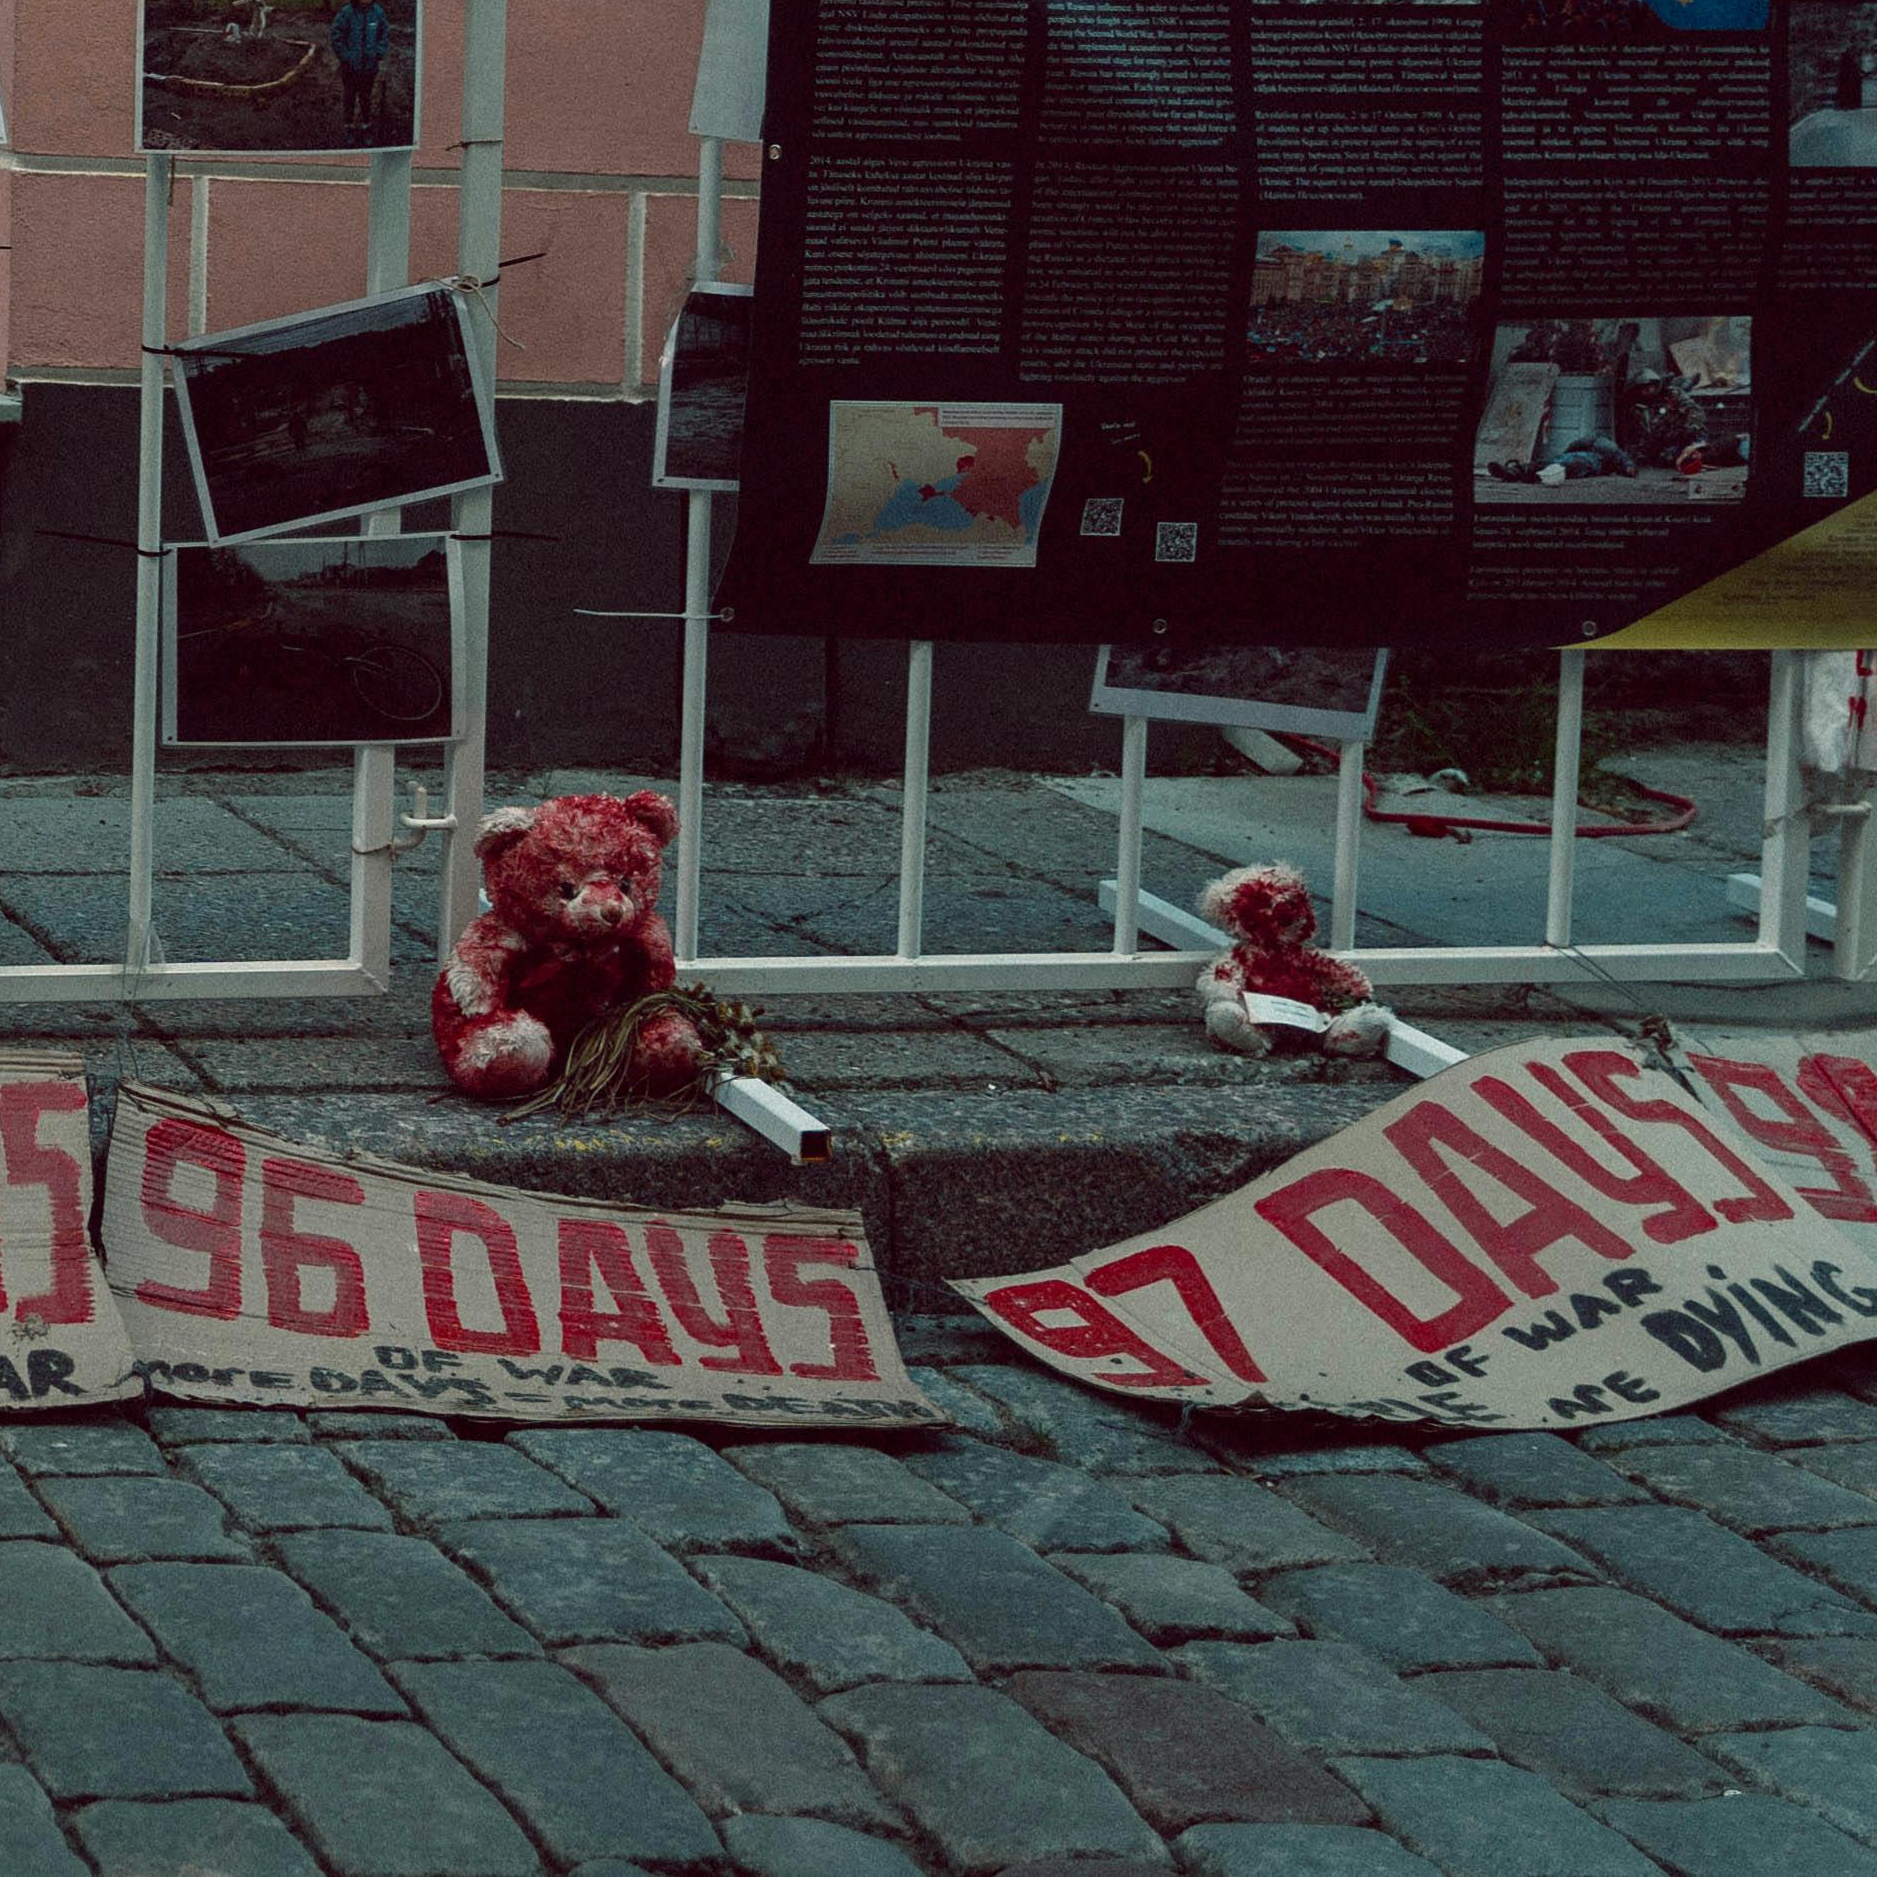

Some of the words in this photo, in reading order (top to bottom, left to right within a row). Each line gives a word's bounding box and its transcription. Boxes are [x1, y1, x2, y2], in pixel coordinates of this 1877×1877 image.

[136, 1118, 370, 1338] 96
[414, 1189, 881, 1383] DAYS
[984, 1244, 1269, 1391] 97
[1253, 1050, 1795, 1354] DAYS
[372, 1343, 463, 1373] OF
[498, 1356, 674, 1390] WAR
[1403, 1345, 1491, 1388] OF
[1501, 1267, 1663, 1353] WAR
